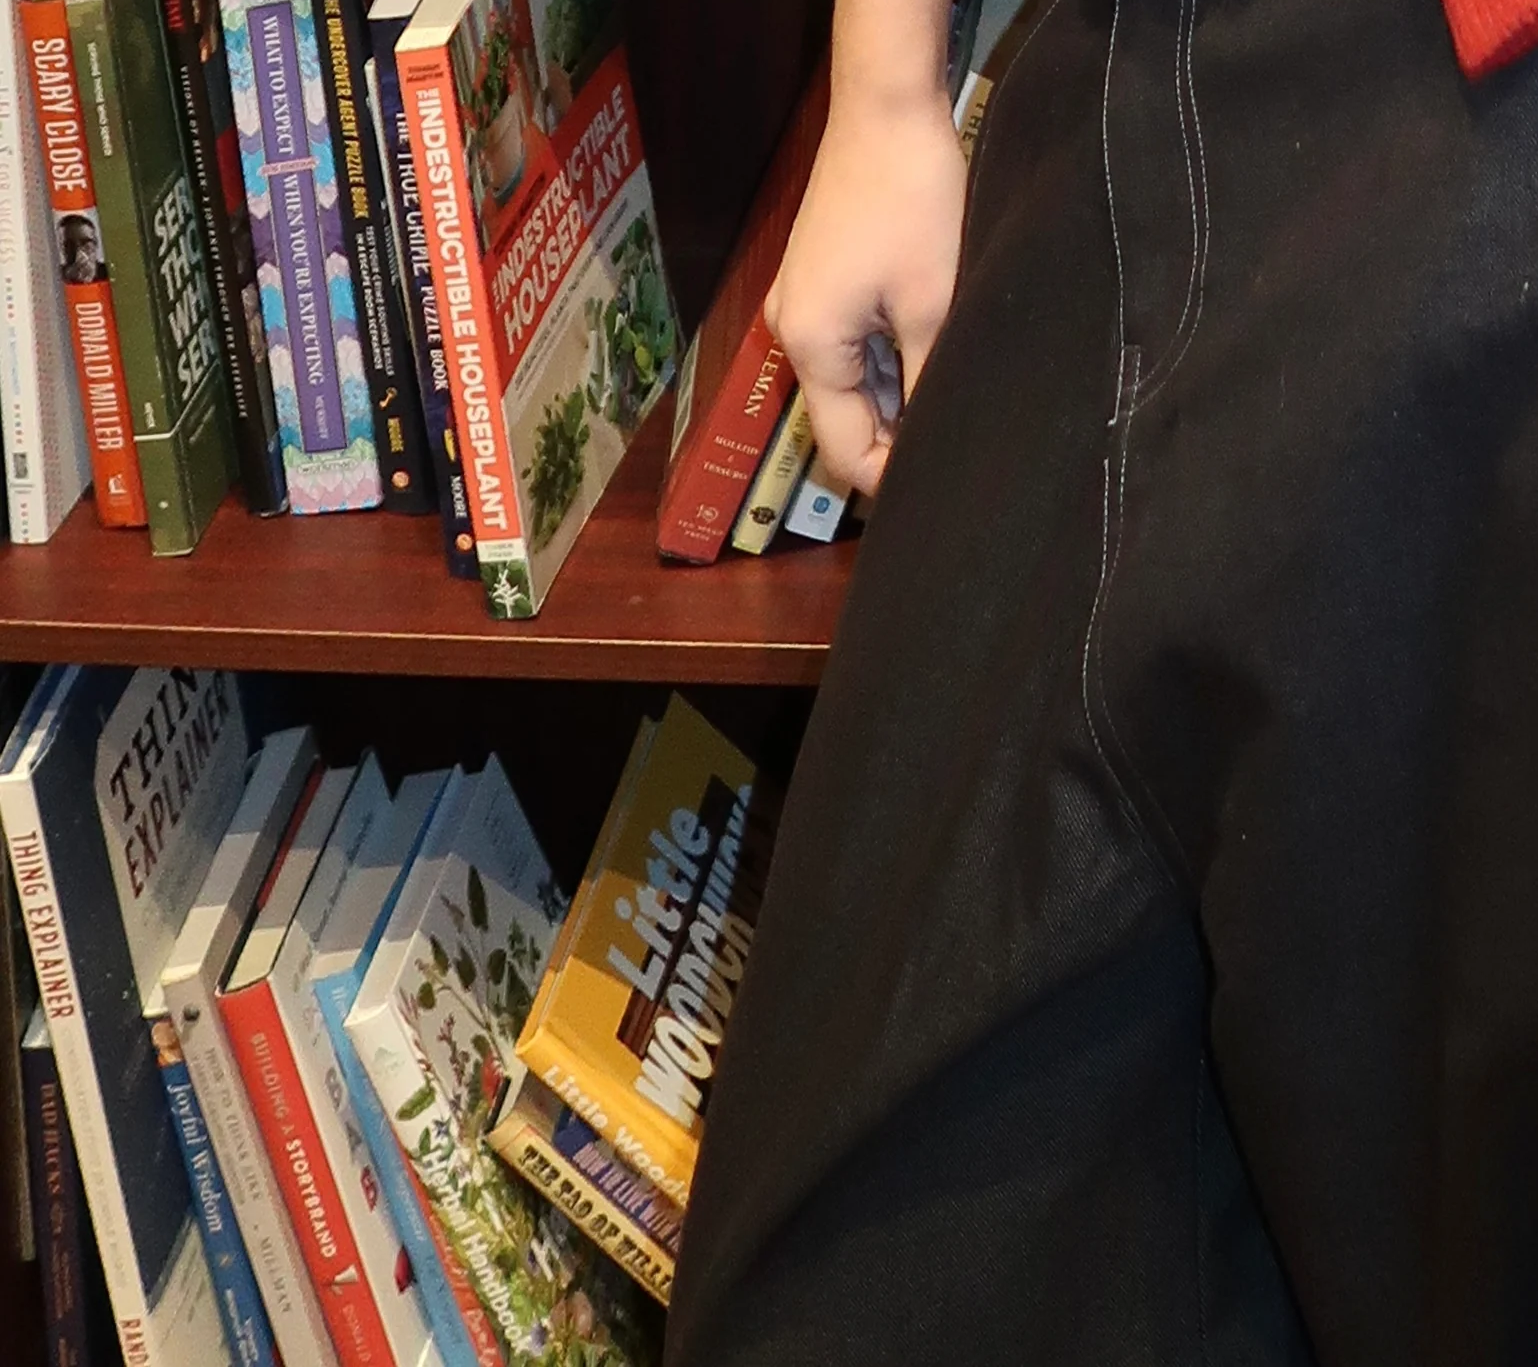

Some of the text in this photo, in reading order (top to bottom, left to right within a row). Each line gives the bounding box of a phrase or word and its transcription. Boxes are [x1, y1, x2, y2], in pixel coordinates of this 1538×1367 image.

[31, 37, 87, 192] SCARY CLOSE
[73, 300, 126, 453] DONALD MILLER
[415, 96, 509, 532] INDESTRUCTIBLE HOUSEPLANT
[10, 829, 75, 1022] THING EXPLAINER
[423, 1150, 534, 1357] Herbal Handbook
